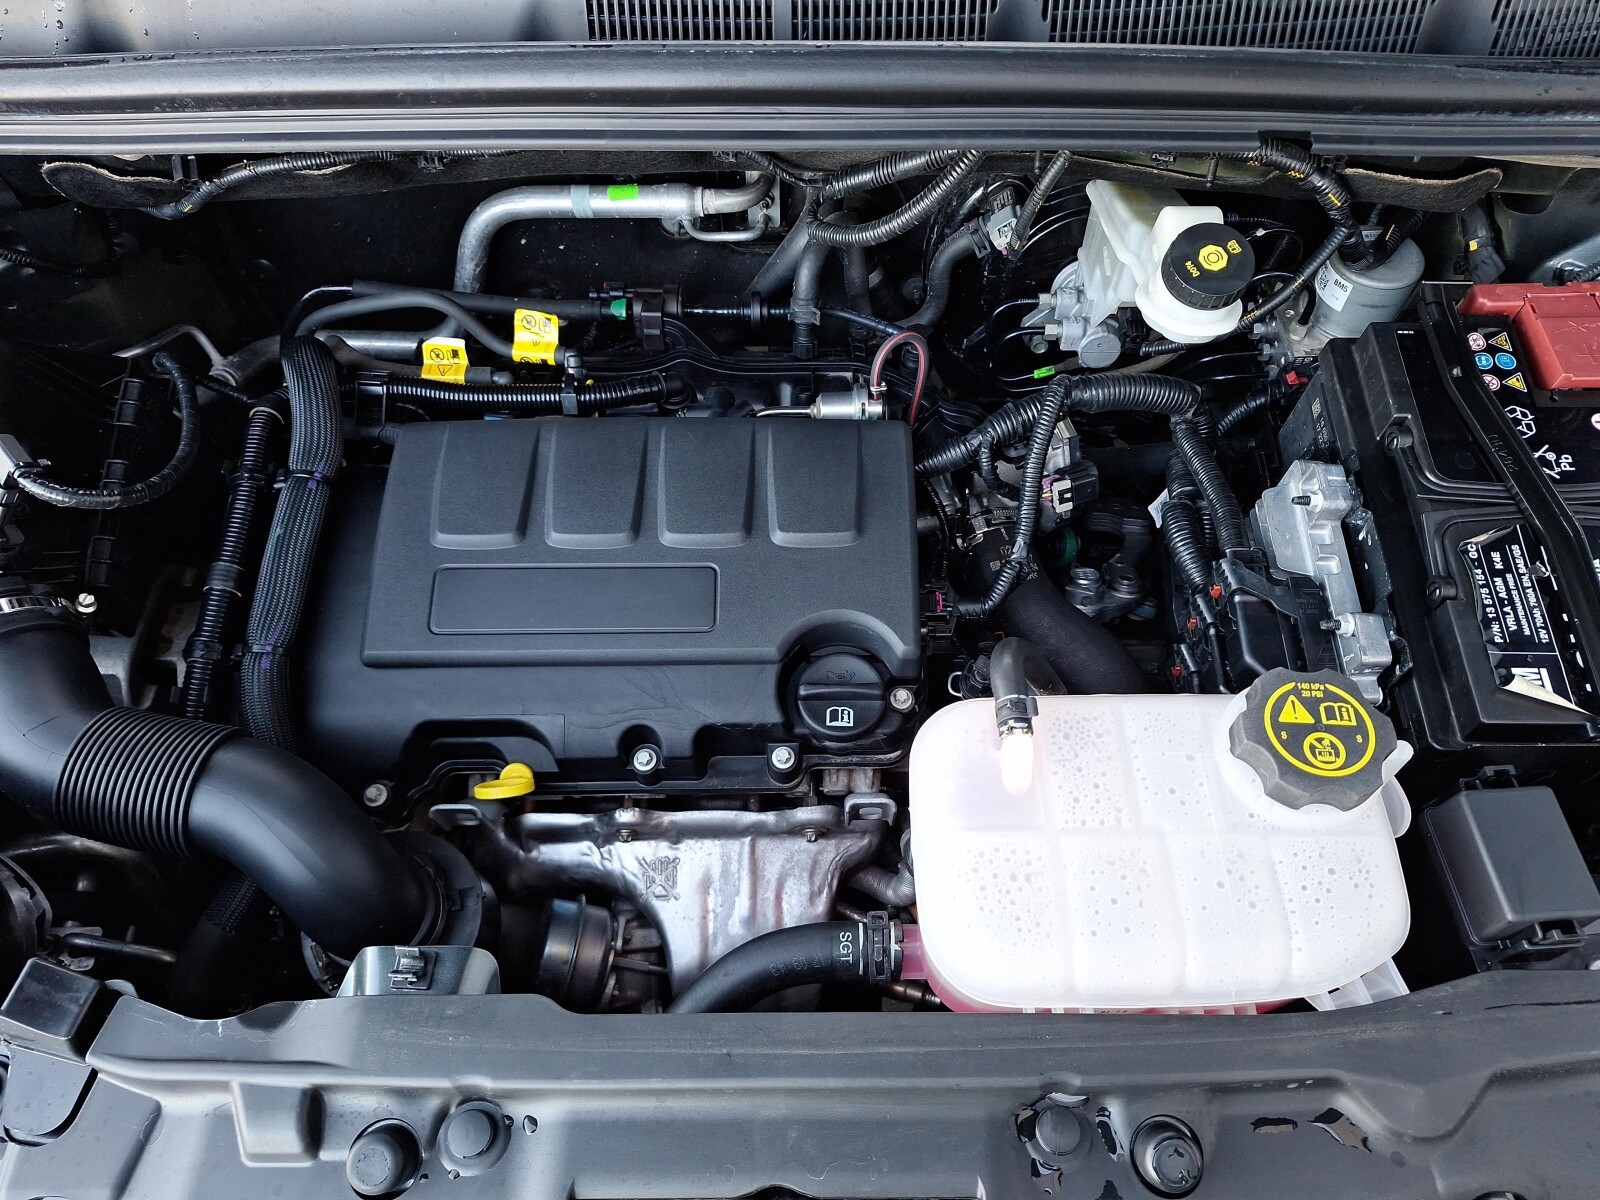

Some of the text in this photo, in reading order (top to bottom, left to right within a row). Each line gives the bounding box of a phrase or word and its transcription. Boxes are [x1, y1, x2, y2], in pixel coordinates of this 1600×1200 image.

[1185, 260, 1200, 278] DOT4
[1559, 454, 1576, 471] Pb
[1467, 543, 1477, 559] GC
[1490, 551, 1504, 569] K4E
[1511, 544, 1528, 574] SAE/GS
[1473, 569, 1485, 585] 154
[1480, 587, 1493, 606] 575
[1493, 577, 1508, 599] AGM
[1486, 607, 1497, 619] 13
[1505, 573, 1531, 636] MAINTENANCE FREE
[1503, 606, 1518, 632] VRLA
[1533, 607, 1545, 629] 70Ah
[1491, 621, 1504, 643] P/N:
[1537, 628, 1550, 644] 12V
[1297, 682, 1325, 691] 140 kPa
[1311, 690, 1324, 698] PSI
[839, 931, 853, 964] SGT
